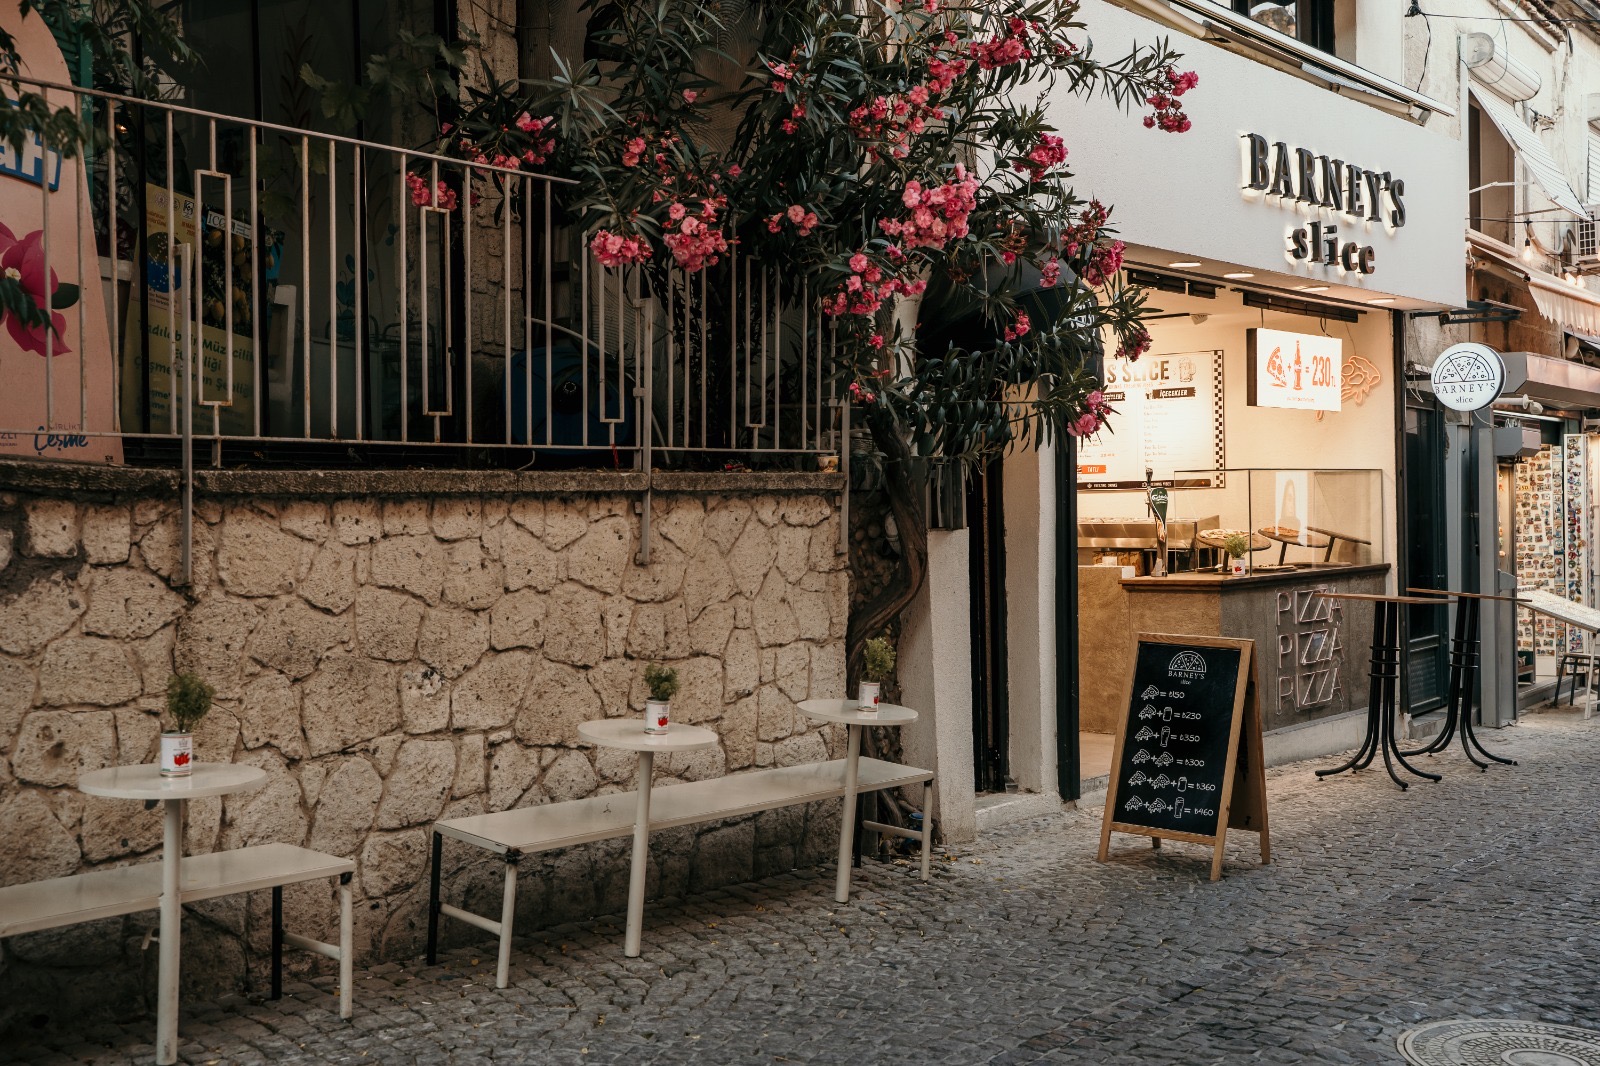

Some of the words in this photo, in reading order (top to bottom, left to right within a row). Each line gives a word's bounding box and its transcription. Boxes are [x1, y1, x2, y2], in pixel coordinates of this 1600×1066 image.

[1243, 132, 1407, 228] BARNEY'S
[1288, 221, 1375, 275] slice
[203, 339, 256, 373] Müzcilik
[1311, 355, 1331, 388] 230
[1434, 382, 1496, 394] BARNEY'S
[1455, 396, 1474, 404] slice
[1277, 587, 1345, 626] PIZZA
[1277, 628, 1345, 669] PIZZA
[1168, 670, 1205, 680] BARNEY'S
[1278, 668, 1345, 711] PIZZA
